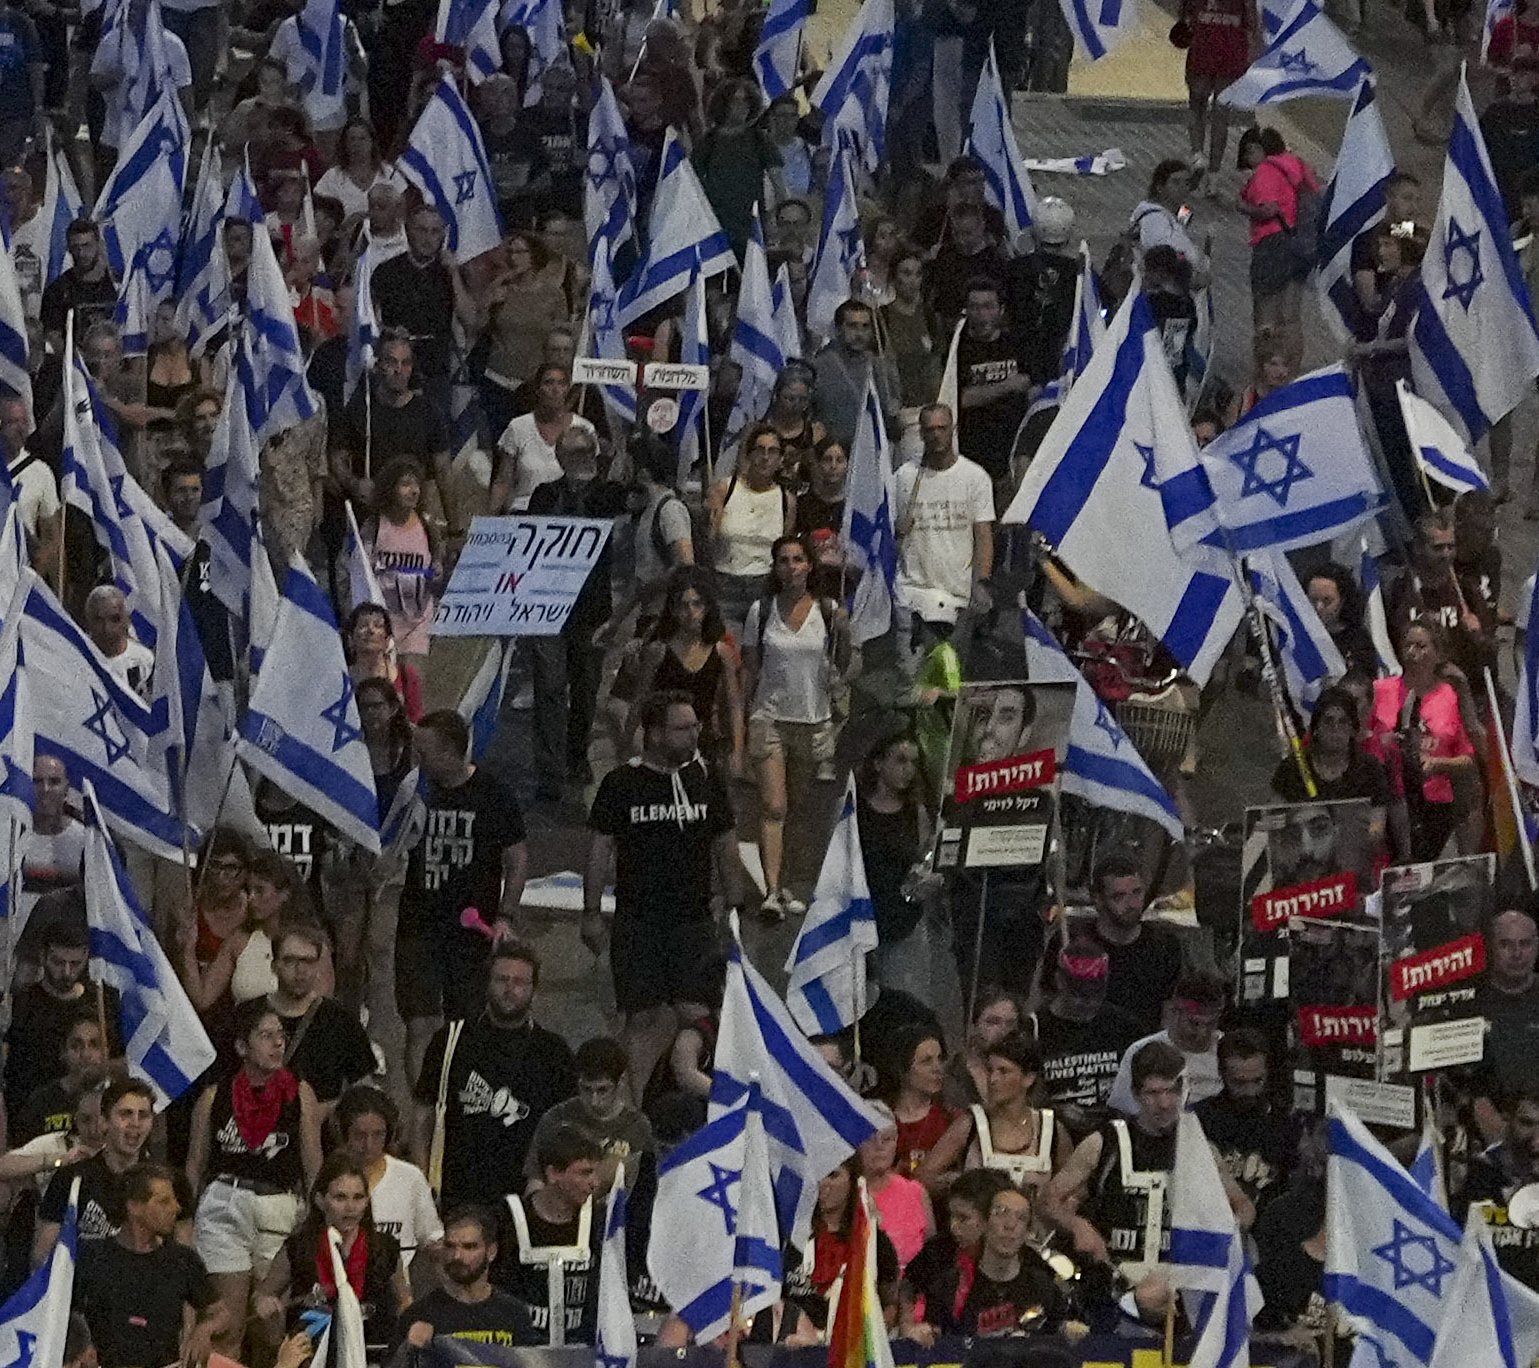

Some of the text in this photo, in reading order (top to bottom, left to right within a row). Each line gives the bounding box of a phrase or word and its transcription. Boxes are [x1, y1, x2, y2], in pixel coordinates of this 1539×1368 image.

[507, 521, 602, 571] חוקה
[494, 572, 526, 595] או
[508, 596, 573, 624] ישראל
[967, 760, 1045, 794] זהירות!
[428, 810, 476, 838] דמו
[630, 803, 718, 824] ELEMENT
[1266, 882, 1346, 922] זהירות!
[1401, 947, 1474, 991] זהירות!
[1314, 1011, 1379, 1038] ירות!
